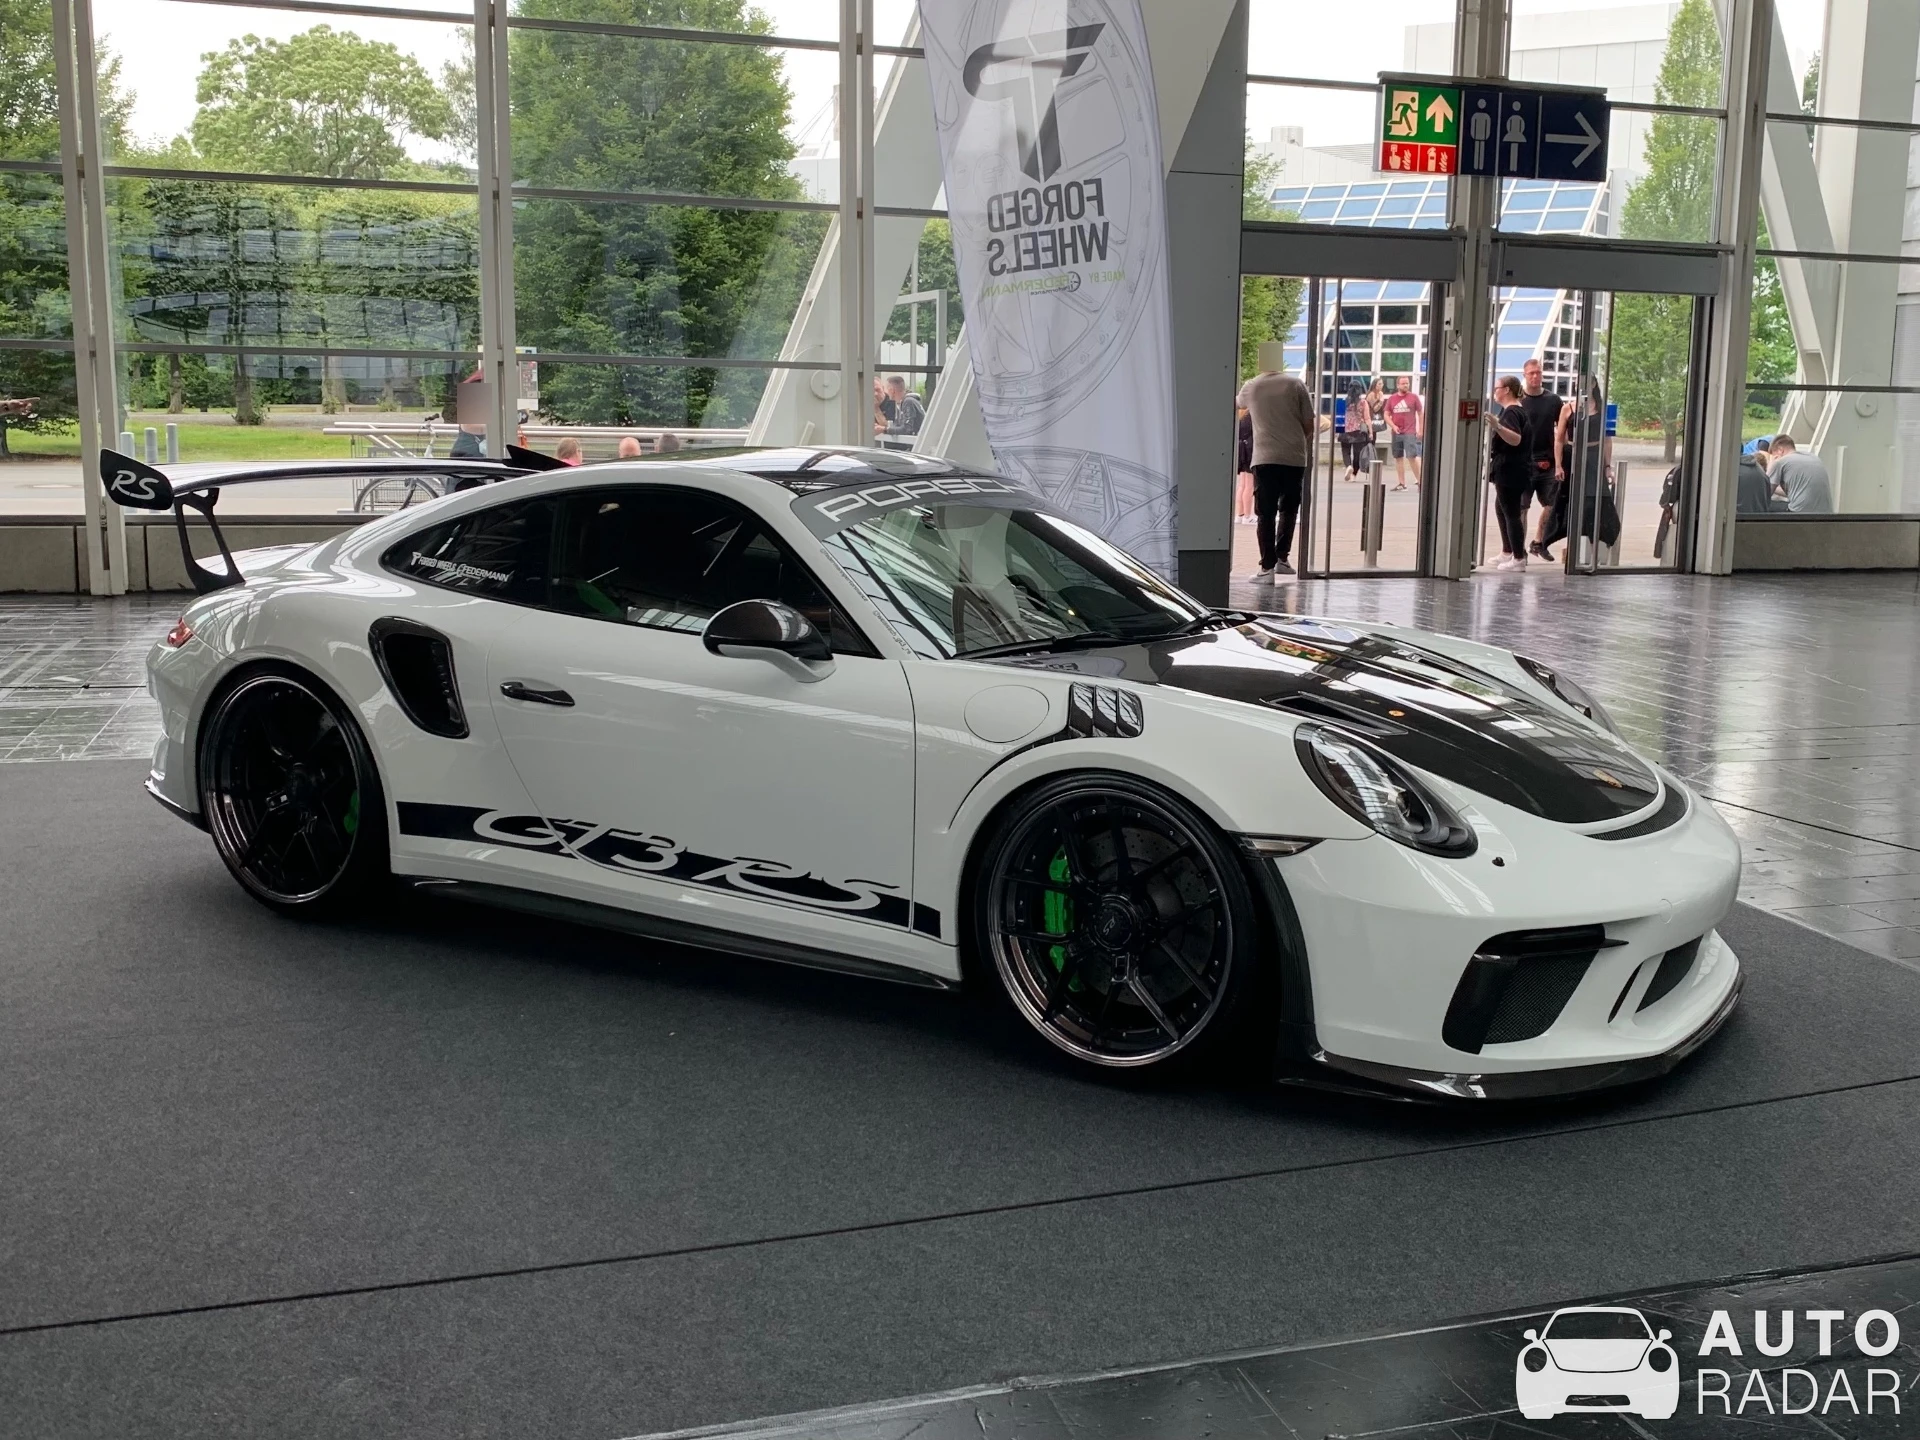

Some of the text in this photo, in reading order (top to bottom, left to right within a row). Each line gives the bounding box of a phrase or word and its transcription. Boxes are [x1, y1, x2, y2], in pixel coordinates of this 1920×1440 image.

[111, 470, 159, 500] RS
[463, 565, 509, 582] FEDERMANN
[473, 807, 901, 911] GT3 RS
